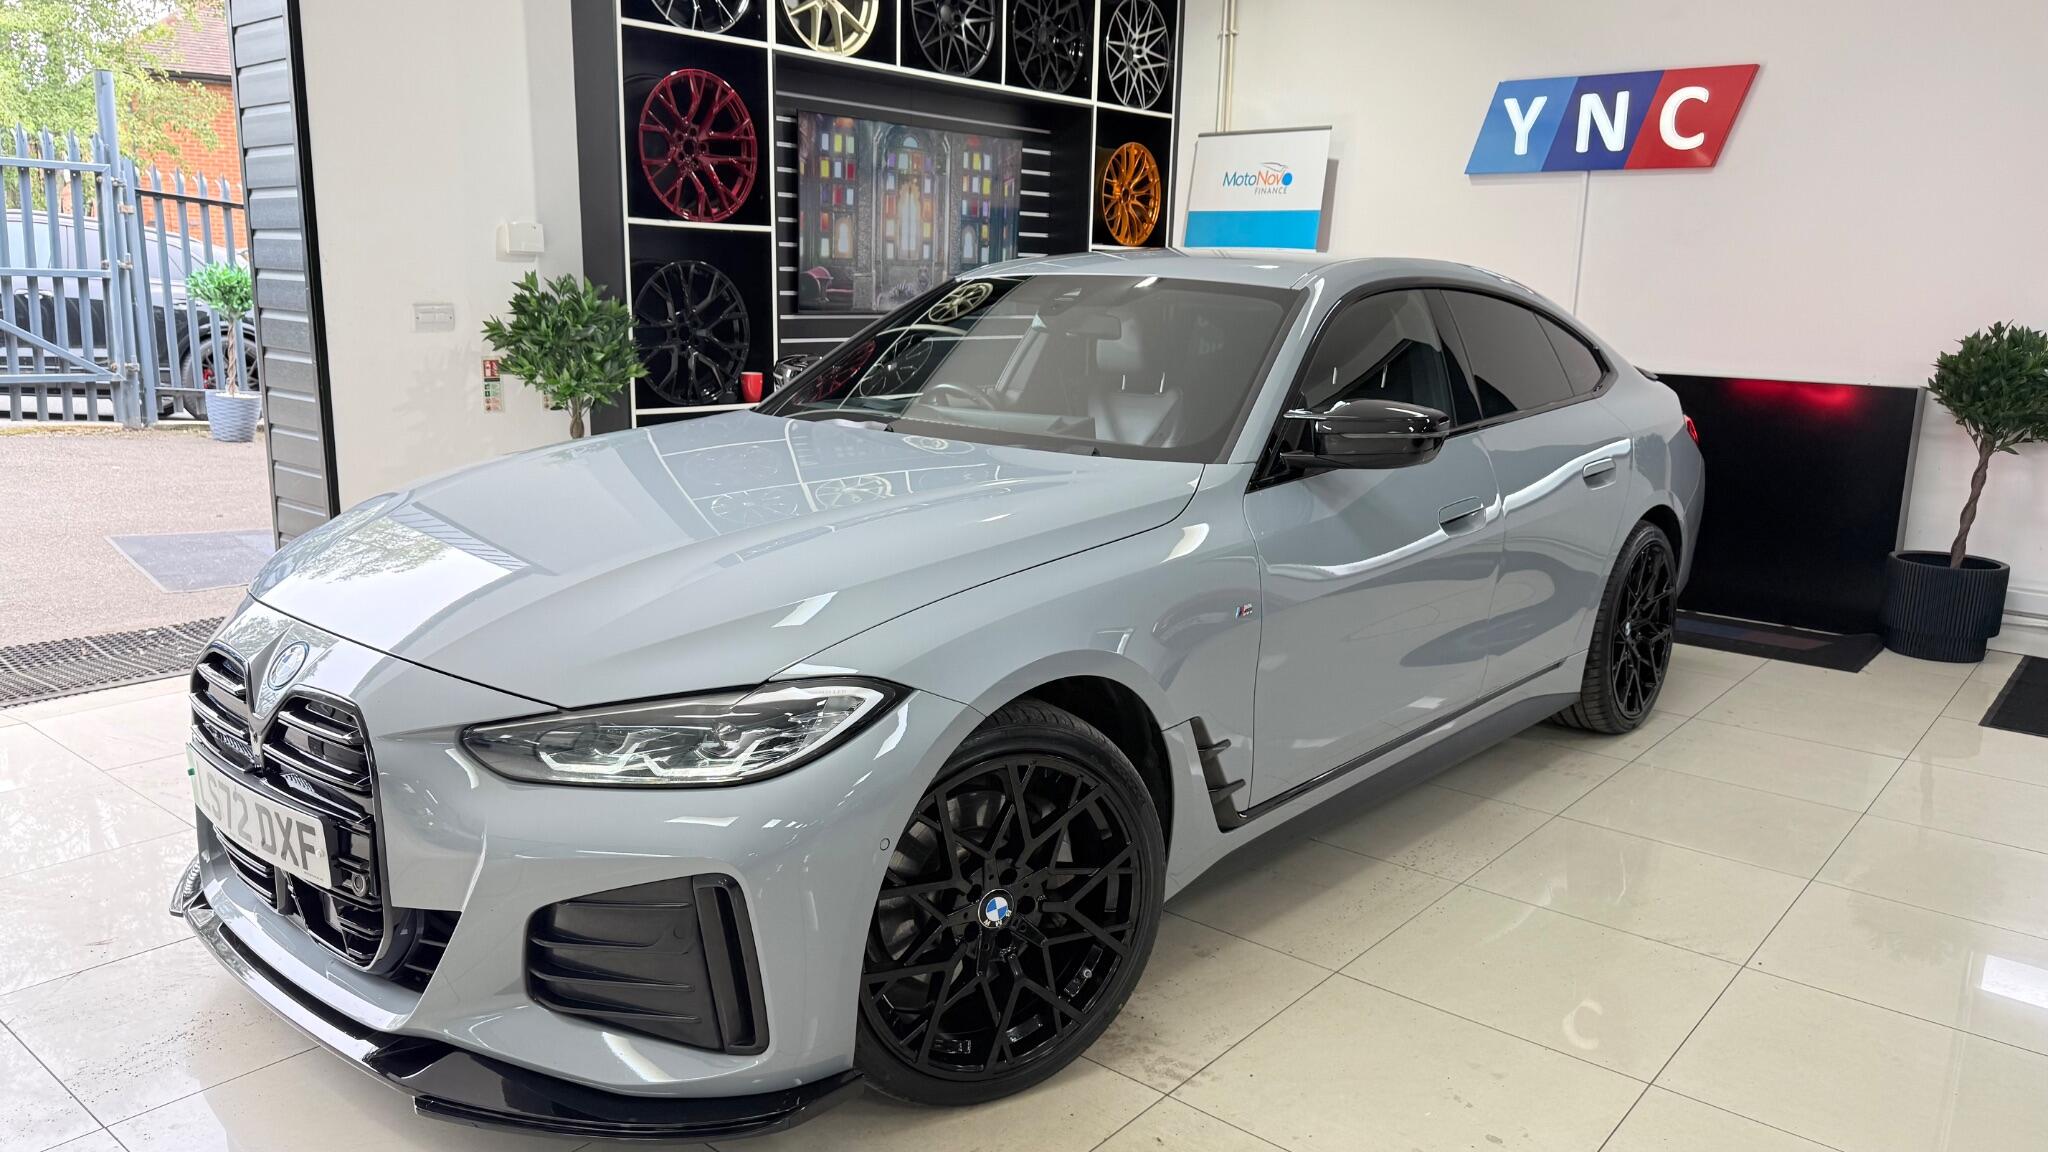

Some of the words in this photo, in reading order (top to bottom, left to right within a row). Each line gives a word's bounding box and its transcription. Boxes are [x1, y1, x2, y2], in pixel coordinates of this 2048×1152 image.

[1504, 86, 1710, 155] YNC
[1222, 170, 1293, 187] MotoNovo
[1254, 187, 1287, 195] FINANCE
[196, 760, 252, 844] LS72
[255, 803, 316, 870] DXF
